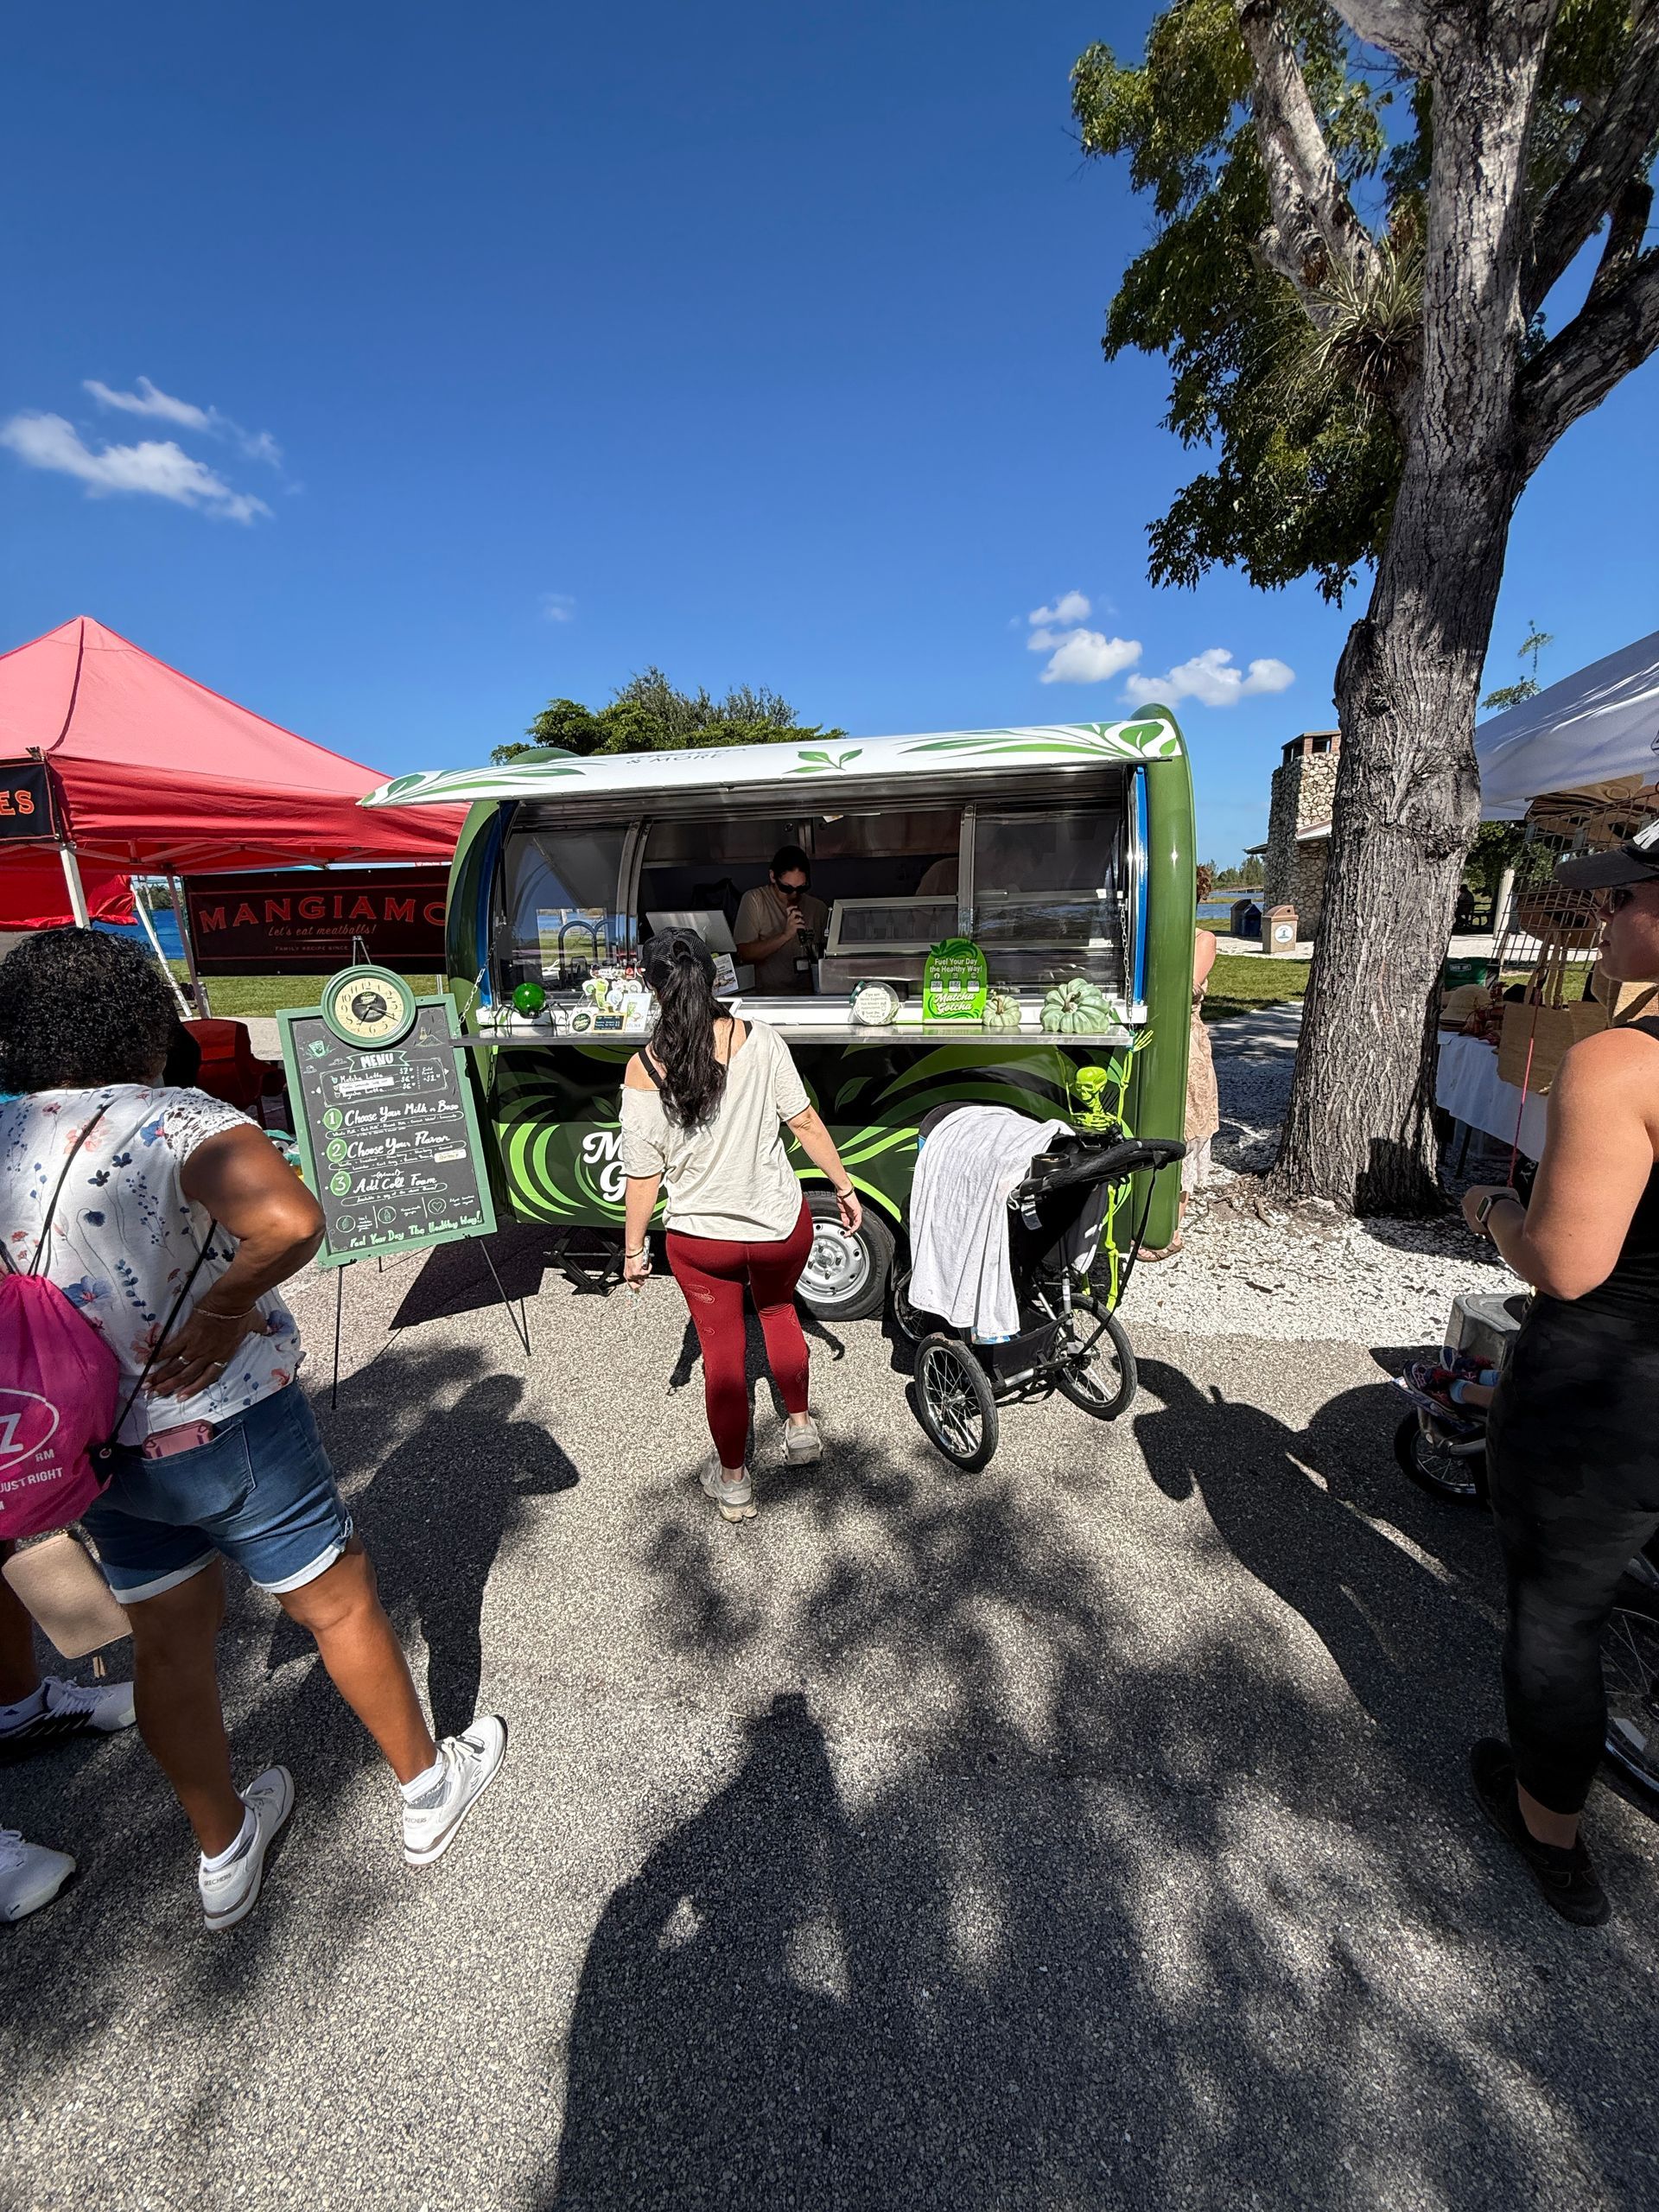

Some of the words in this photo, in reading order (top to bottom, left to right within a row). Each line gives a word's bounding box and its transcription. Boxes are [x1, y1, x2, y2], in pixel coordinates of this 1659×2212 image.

[650, 753, 723, 764] MORE
[268, 925, 292, 937] Let's
[296, 926, 314, 936] eat
[316, 924, 378, 936] meatballs!
[941, 965, 966, 974] Healthy
[933, 992, 976, 1003] Matcha
[936, 1002, 973, 1015] Gotcha
[360, 1052, 394, 1069] MENU
[329, 1111, 335, 1125] 1
[345, 1109, 378, 1127] Choose
[379, 1106, 401, 1122] Your
[404, 1103, 428, 1115] Milk
[438, 1100, 459, 1113] Base
[332, 1144, 342, 1157] 2
[347, 1141, 384, 1159] Choose
[385, 1137, 411, 1154] Your
[415, 1131, 451, 1147] Flavor
[335, 1176, 346, 1191] 3
[353, 1178, 378, 1194] Add
[381, 1176, 404, 1190] Cold
[410, 1173, 437, 1186] Foam
[370, 1232, 386, 1245] Your
[387, 1230, 404, 1242] Day
[409, 1225, 425, 1236] The
[460, 1211, 482, 1225] Way!
[35, 1448, 54, 1463] RM
[0, 1477, 27, 1493] JUST
[28, 1467, 63, 1485] RIGHT
